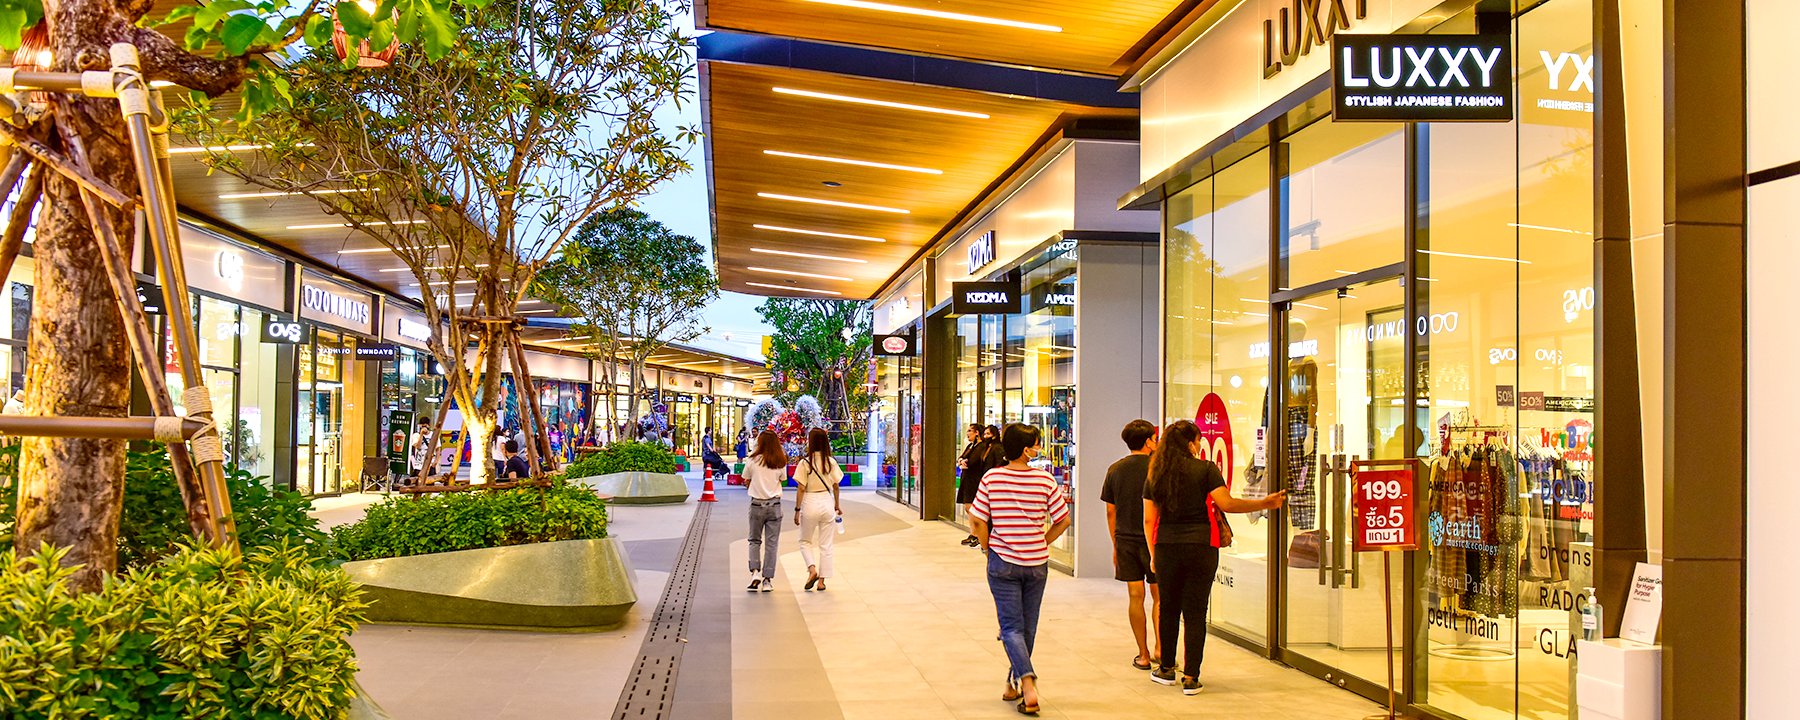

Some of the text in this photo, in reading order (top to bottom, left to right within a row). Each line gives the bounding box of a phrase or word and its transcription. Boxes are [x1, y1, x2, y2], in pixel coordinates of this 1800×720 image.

[1343, 46, 1502, 88] LUXXY
[1345, 95, 1504, 108] STYLISH JAPANESE FASHION
[967, 230, 995, 275] KEDMA
[965, 291, 1009, 304] KEDMA
[322, 288, 369, 325] OWNDAYS
[268, 322, 302, 340] OVS
[356, 347, 394, 357] OWNDAYS
[1497, 390, 1514, 403] 50%
[1520, 396, 1543, 408] 50%
[1204, 412, 1219, 425] SALE
[1365, 505, 1404, 528] ซื้อ 5
[1445, 515, 1482, 540] earth
[1368, 529, 1401, 542] แถม 1
[1445, 538, 1499, 556] music&ecology
[1427, 566, 1499, 598] Green Parks
[1637, 575, 1655, 584] Sanitizer
[1633, 589, 1651, 598] Purpose
[1428, 606, 1499, 641] petit main
